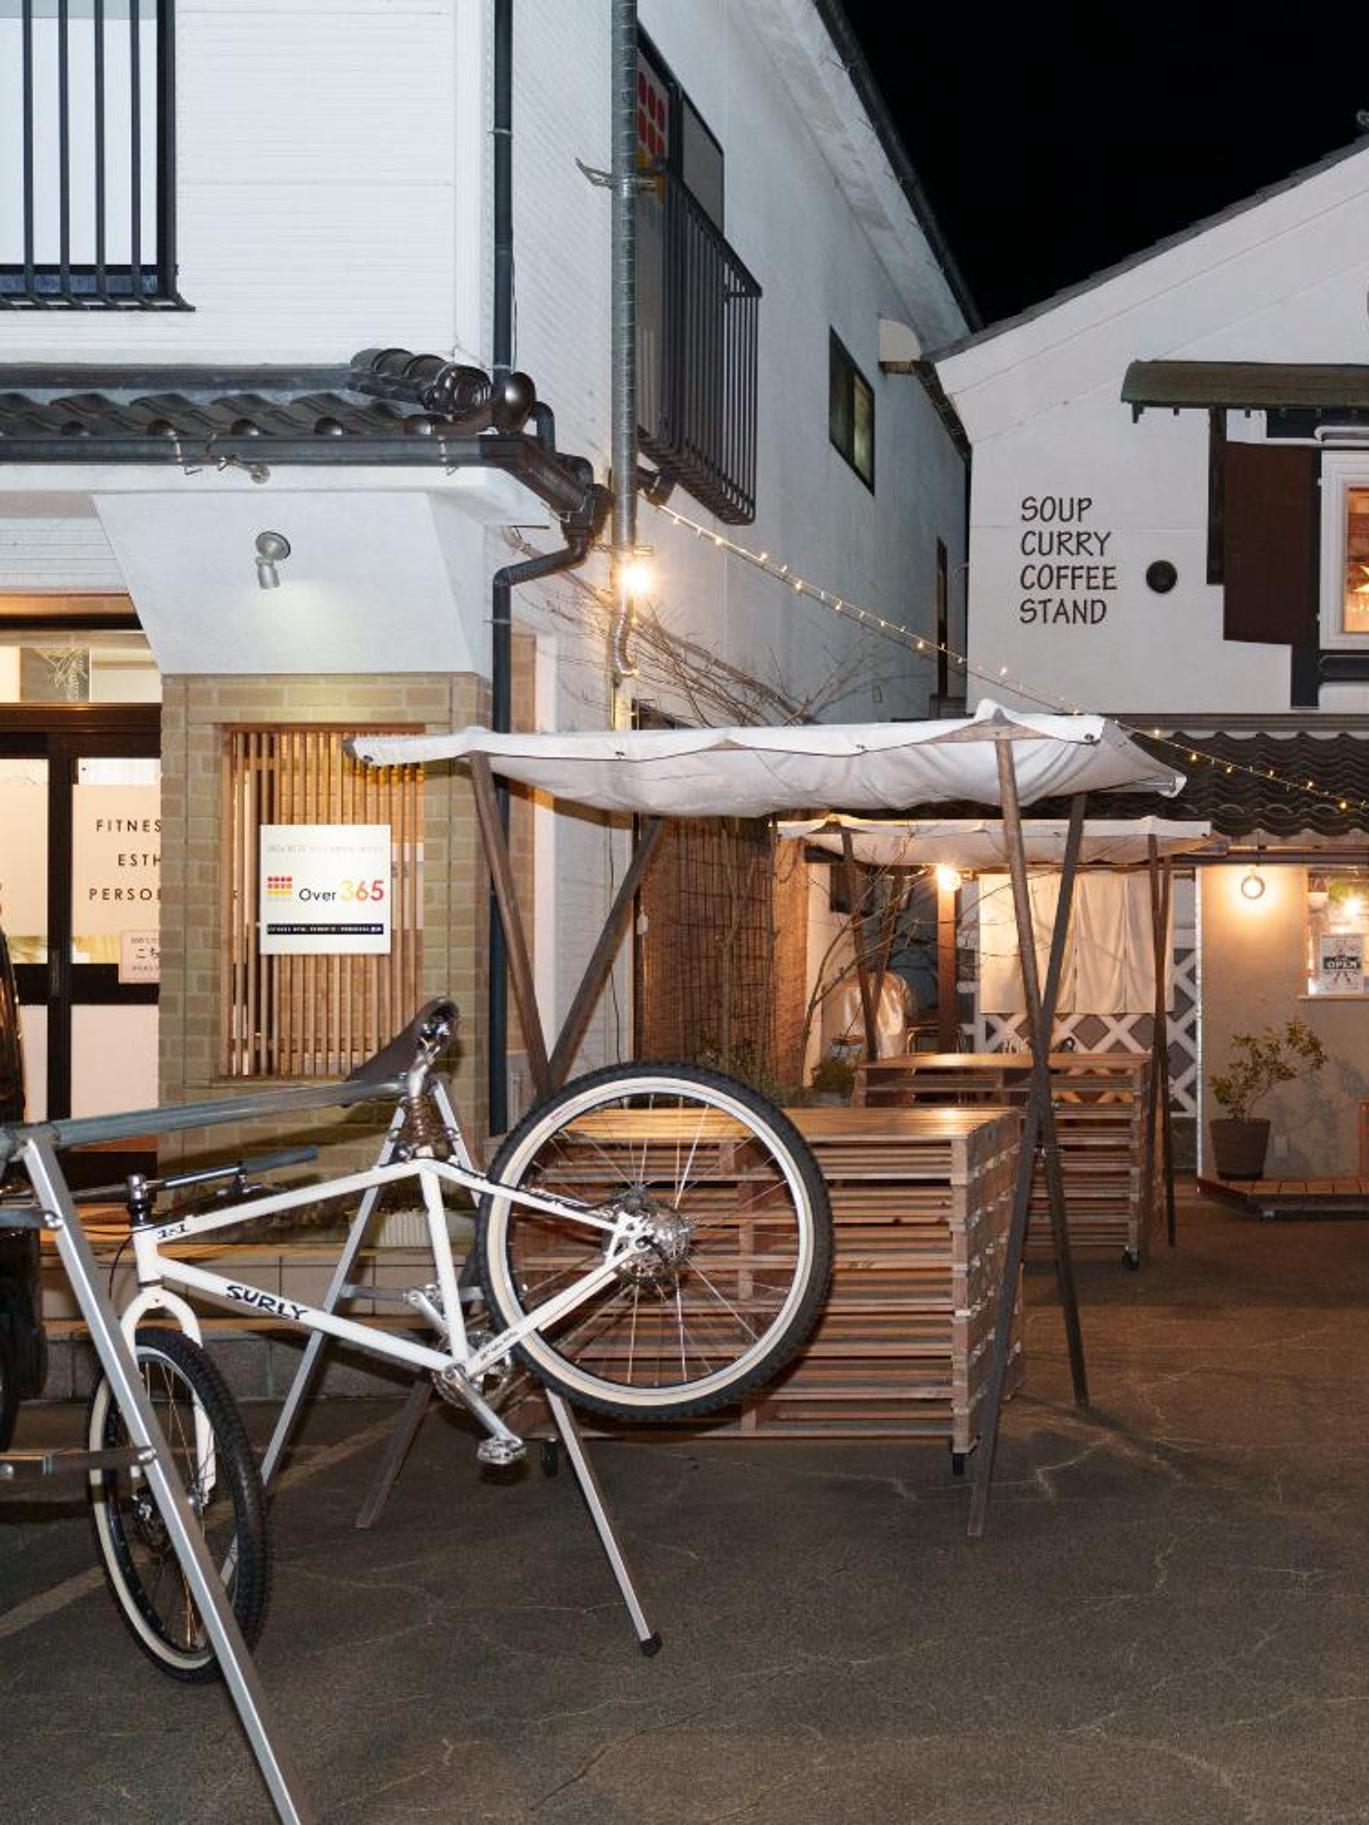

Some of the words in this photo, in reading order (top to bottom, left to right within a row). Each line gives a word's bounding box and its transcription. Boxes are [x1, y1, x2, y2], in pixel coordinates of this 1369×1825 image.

[1021, 496, 1093, 522] SOUP
[1021, 530, 1111, 556] CURRY
[1020, 564, 1118, 590] COFFEE
[1020, 598, 1107, 624] STAND
[89, 888, 161, 901] PERSO
[299, 887, 336, 902] Over
[340, 879, 384, 902] 365
[225, 1285, 308, 1320] SURLY
